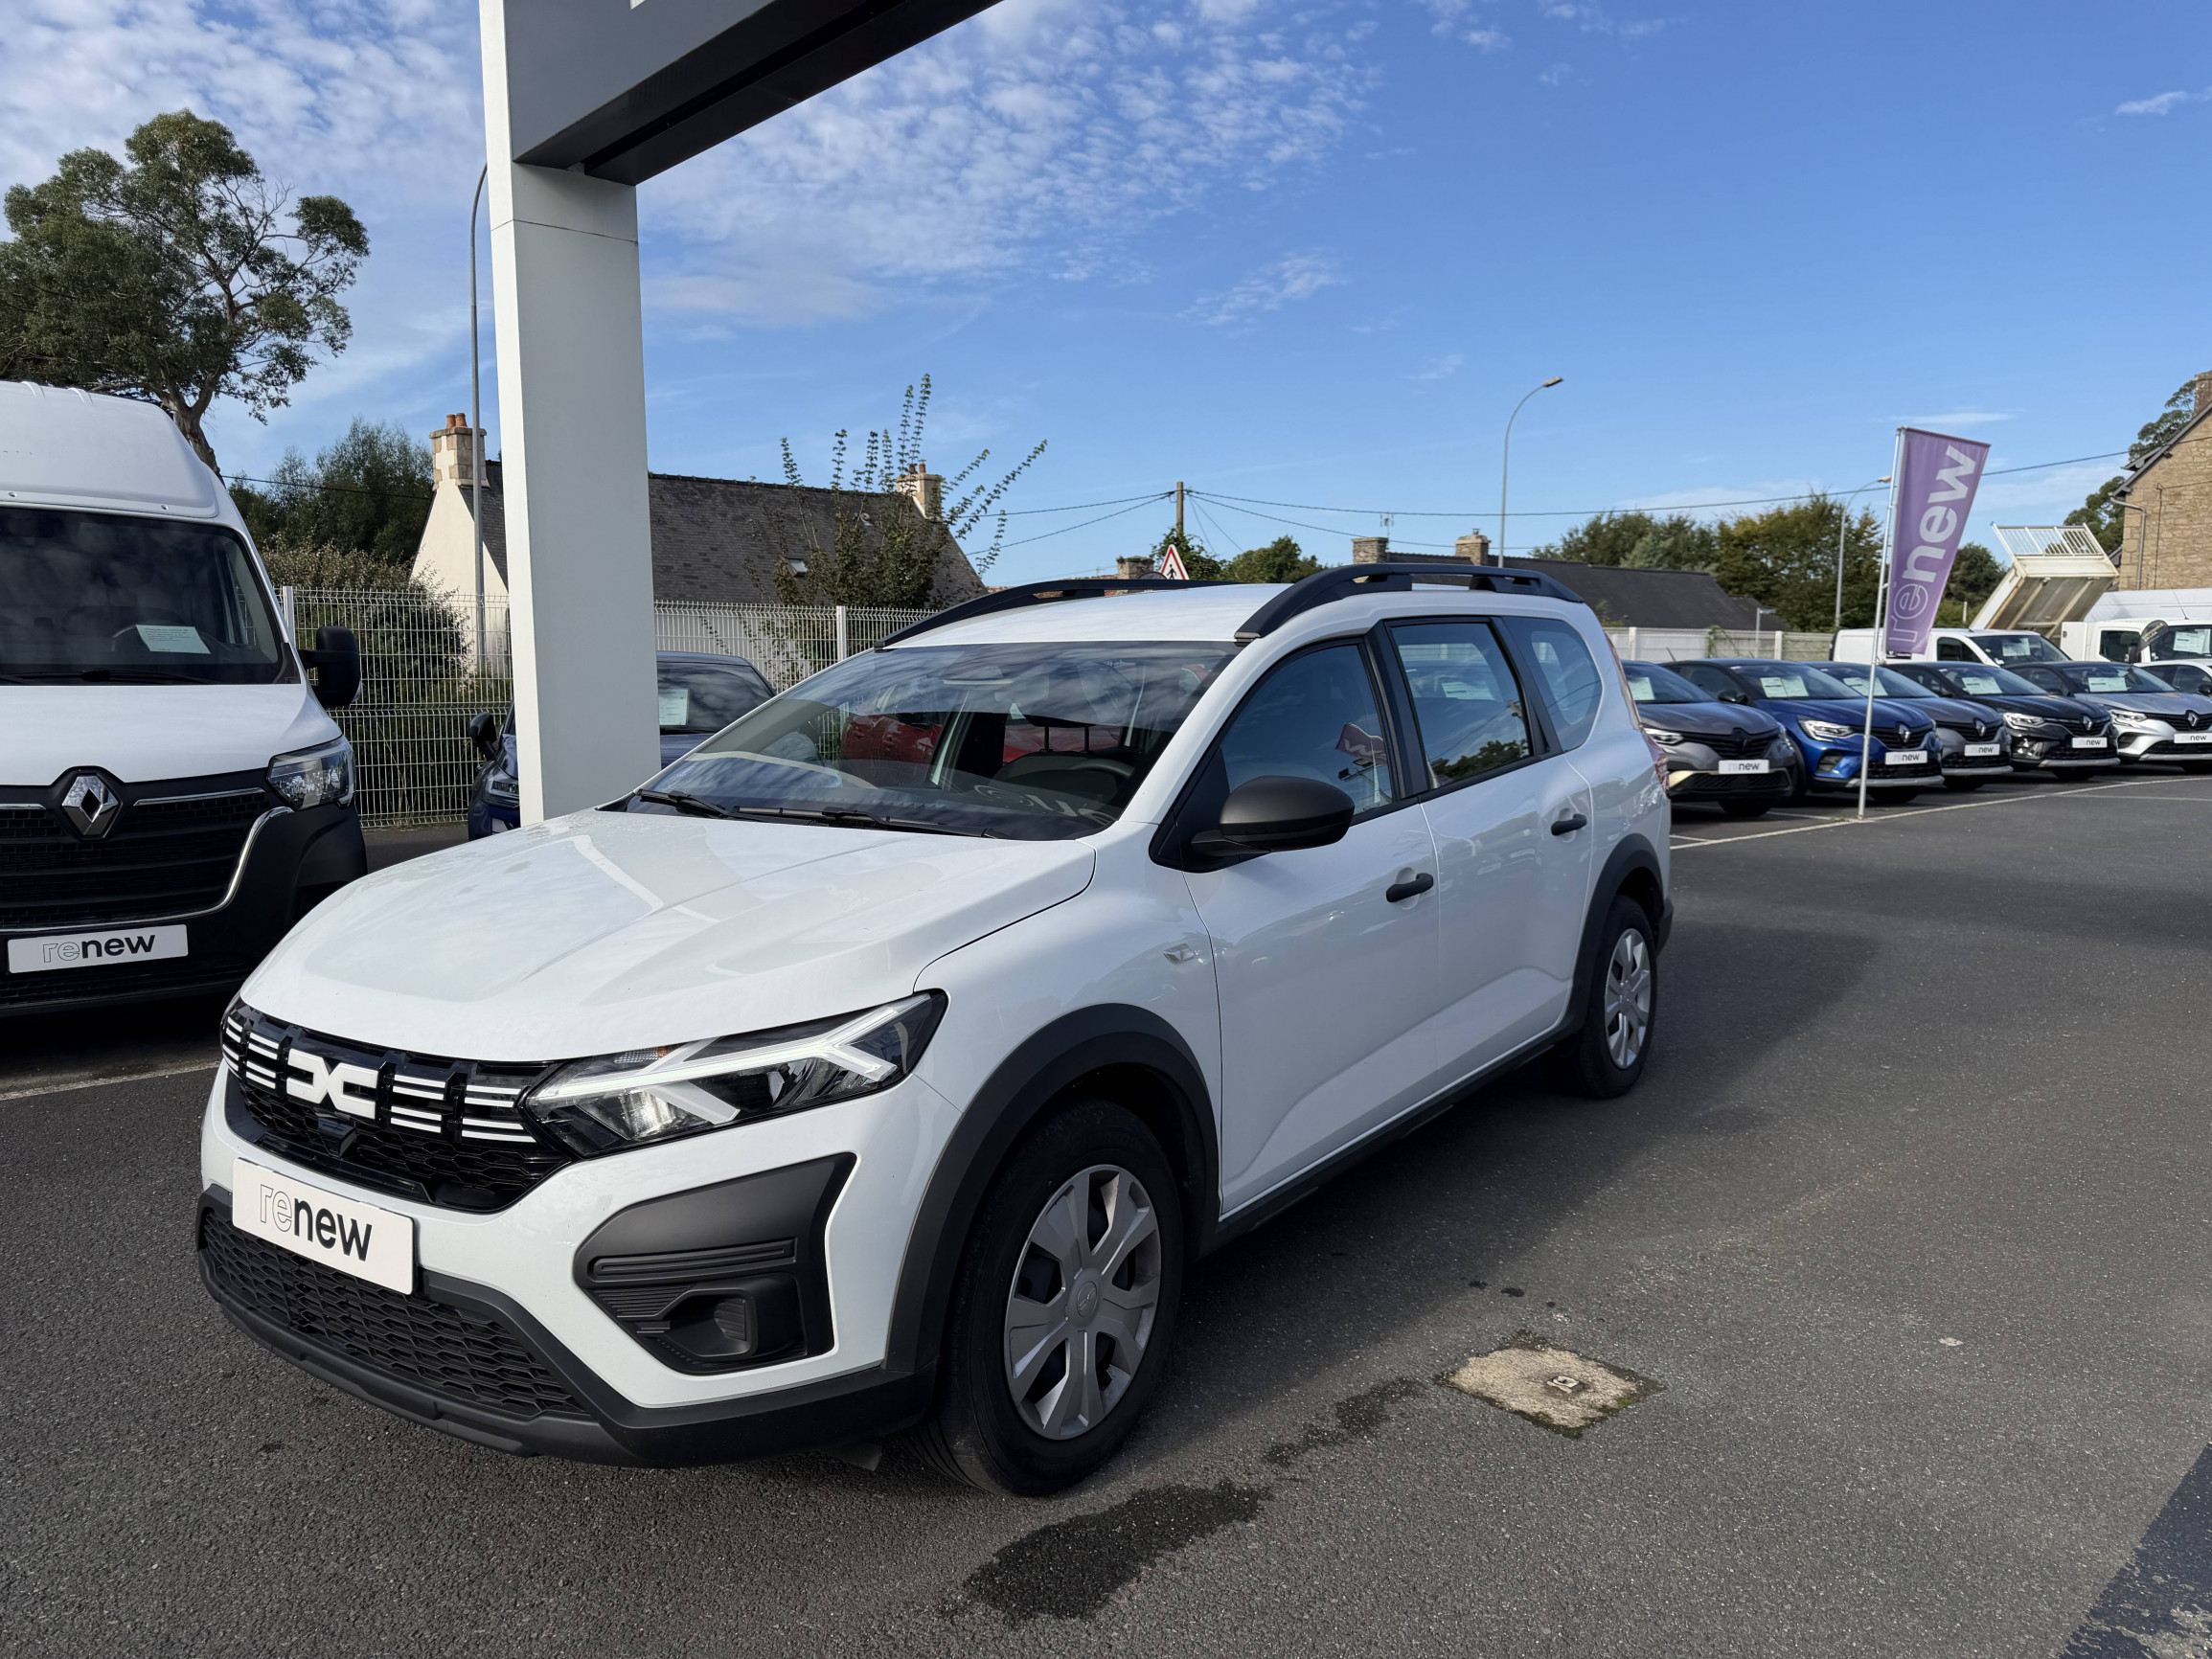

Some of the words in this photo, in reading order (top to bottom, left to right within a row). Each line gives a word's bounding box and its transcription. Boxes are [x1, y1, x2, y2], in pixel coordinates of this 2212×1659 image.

[1888, 444, 1976, 643] renew
[1893, 753, 1921, 761] new
[43, 935, 156, 964] renew
[260, 1184, 373, 1262] renew
